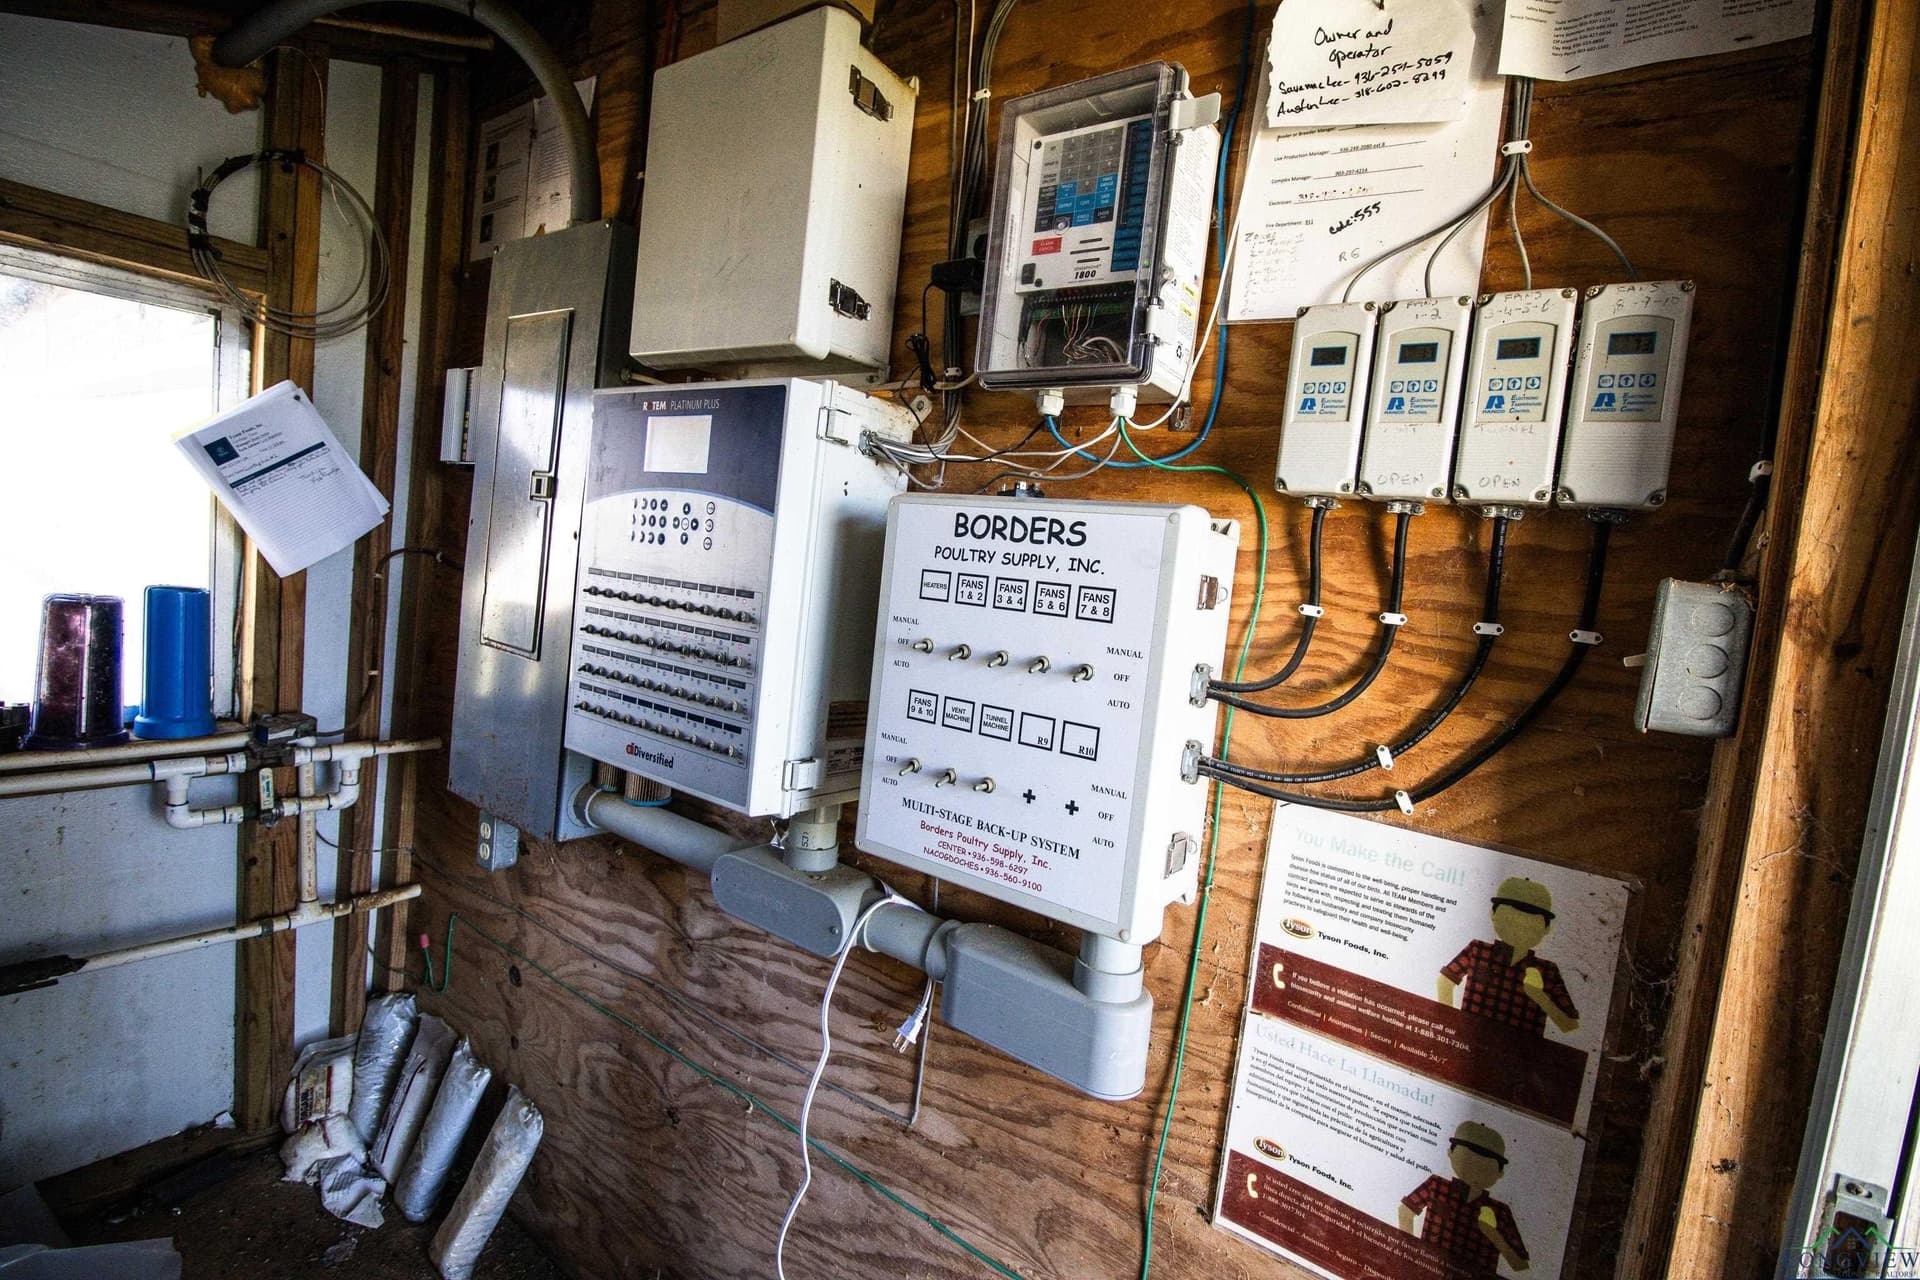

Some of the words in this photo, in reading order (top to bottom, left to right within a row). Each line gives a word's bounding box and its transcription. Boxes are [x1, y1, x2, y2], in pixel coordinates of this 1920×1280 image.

[1314, 27, 1360, 46] Owner
[1366, 18, 1393, 39] and
[1277, 102, 1319, 117] Austin
[1284, 151, 1308, 160] Production
[1075, 270, 1096, 280] 1800
[670, 400, 702, 410] PLATINUM
[704, 399, 720, 409] PLUS
[1479, 475, 1521, 488] OPEN
[954, 512, 1087, 546] BORDERS
[935, 546, 996, 564] POULTRY
[1001, 552, 1060, 573] SUPPLY,
[1068, 557, 1105, 575] INC.
[923, 582, 947, 590] HEATERS
[961, 579, 983, 589] FANS
[999, 584, 1023, 594] FANS
[960, 590, 964, 599] 1
[967, 591, 973, 599] &
[977, 592, 983, 601] 2
[1040, 588, 1065, 599] FANS
[1083, 592, 1110, 604] FANS
[996, 595, 1002, 603] 3
[1007, 596, 1013, 604] &
[1017, 597, 1023, 606] 4
[1037, 600, 1043, 609] 5
[1047, 601, 1054, 610] &
[1059, 602, 1065, 611] 6
[1081, 604, 1087, 614] 7
[1091, 606, 1098, 615] &
[1103, 607, 1110, 617] 8
[893, 615, 919, 625] MANUAL
[897, 638, 910, 646] OFF
[1107, 646, 1144, 660] MANUAL
[893, 659, 910, 669] AUTO
[1113, 673, 1130, 683] OFF
[914, 697, 932, 707] FANS
[1107, 699, 1130, 710] AUTO
[926, 709, 933, 717] 10
[952, 706, 966, 715] VENT
[946, 712, 970, 723] MACHINE
[986, 714, 1008, 724] TUNNEL
[983, 721, 1009, 732] MACHINE
[881, 732, 908, 745] MANUAL
[1037, 735, 1049, 745] R9
[1079, 745, 1095, 757] R10
[886, 755, 898, 764] OFF
[881, 776, 898, 787] AUTO
[1091, 783, 1127, 800] MANUAL
[1098, 811, 1115, 822] OFF
[902, 797, 973, 827] MULTI-STAGE
[977, 819, 1028, 843] BACK-UP
[1031, 836, 1080, 860] SYSTEM
[920, 820, 953, 839] Borders
[957, 832, 989, 851] Poultry
[1032, 855, 1052, 870] Inc.
[1092, 836, 1114, 849] AUTO
[1294, 826, 1323, 848] You
[1329, 835, 1378, 863] Make
[1384, 850, 1413, 873] the
[1420, 859, 1466, 887] Call!
[1290, 853, 1304, 862] Tyson
[1305, 858, 1320, 867] Foods
[1326, 863, 1354, 876] committed
[1361, 873, 1370, 881] the
[1401, 885, 1420, 895] proper
[1420, 890, 1444, 902] handling
[1445, 897, 1457, 905] and
[1285, 917, 1314, 937] Tyson
[1317, 930, 1341, 945] Tyson
[1343, 938, 1371, 954] Foods,
[1373, 948, 1389, 960] Inc.
[1290, 981, 1321, 998] biosecurity
[1323, 993, 1335, 1003] and
[1335, 997, 1356, 1011] animal
[1357, 1005, 1380, 1019] welfare
[1381, 1014, 1404, 1028] hotline
[1405, 1022, 1412, 1031] at
[1292, 971, 1297, 979] If
[1297, 973, 1308, 983] you
[1309, 977, 1330, 991] believe
[1331, 985, 1335, 993] a
[1336, 987, 1362, 1002] violation
[1363, 997, 1375, 1007] has
[1408, 1012, 1429, 1026] please
[1430, 1021, 1443, 1031] call
[1444, 1025, 1456, 1035] our
[1287, 999, 1321, 1018] Confidential
[1327, 1014, 1363, 1034] Anonymous
[1370, 1030, 1392, 1045] Secure
[1399, 1041, 1428, 1058] Available
[1428, 1052, 1447, 1065] 24/7
[1255, 1023, 1295, 1051] Usted
[1298, 1041, 1336, 1068] Hace
[1339, 1057, 1357, 1076] La
[1362, 1065, 1434, 1109] Llamada!
[1258, 1137, 1283, 1158] Tyson
[1288, 1154, 1310, 1171] Tyson
[1311, 1165, 1337, 1184] Foods,
[1338, 1177, 1354, 1192] Inc.
